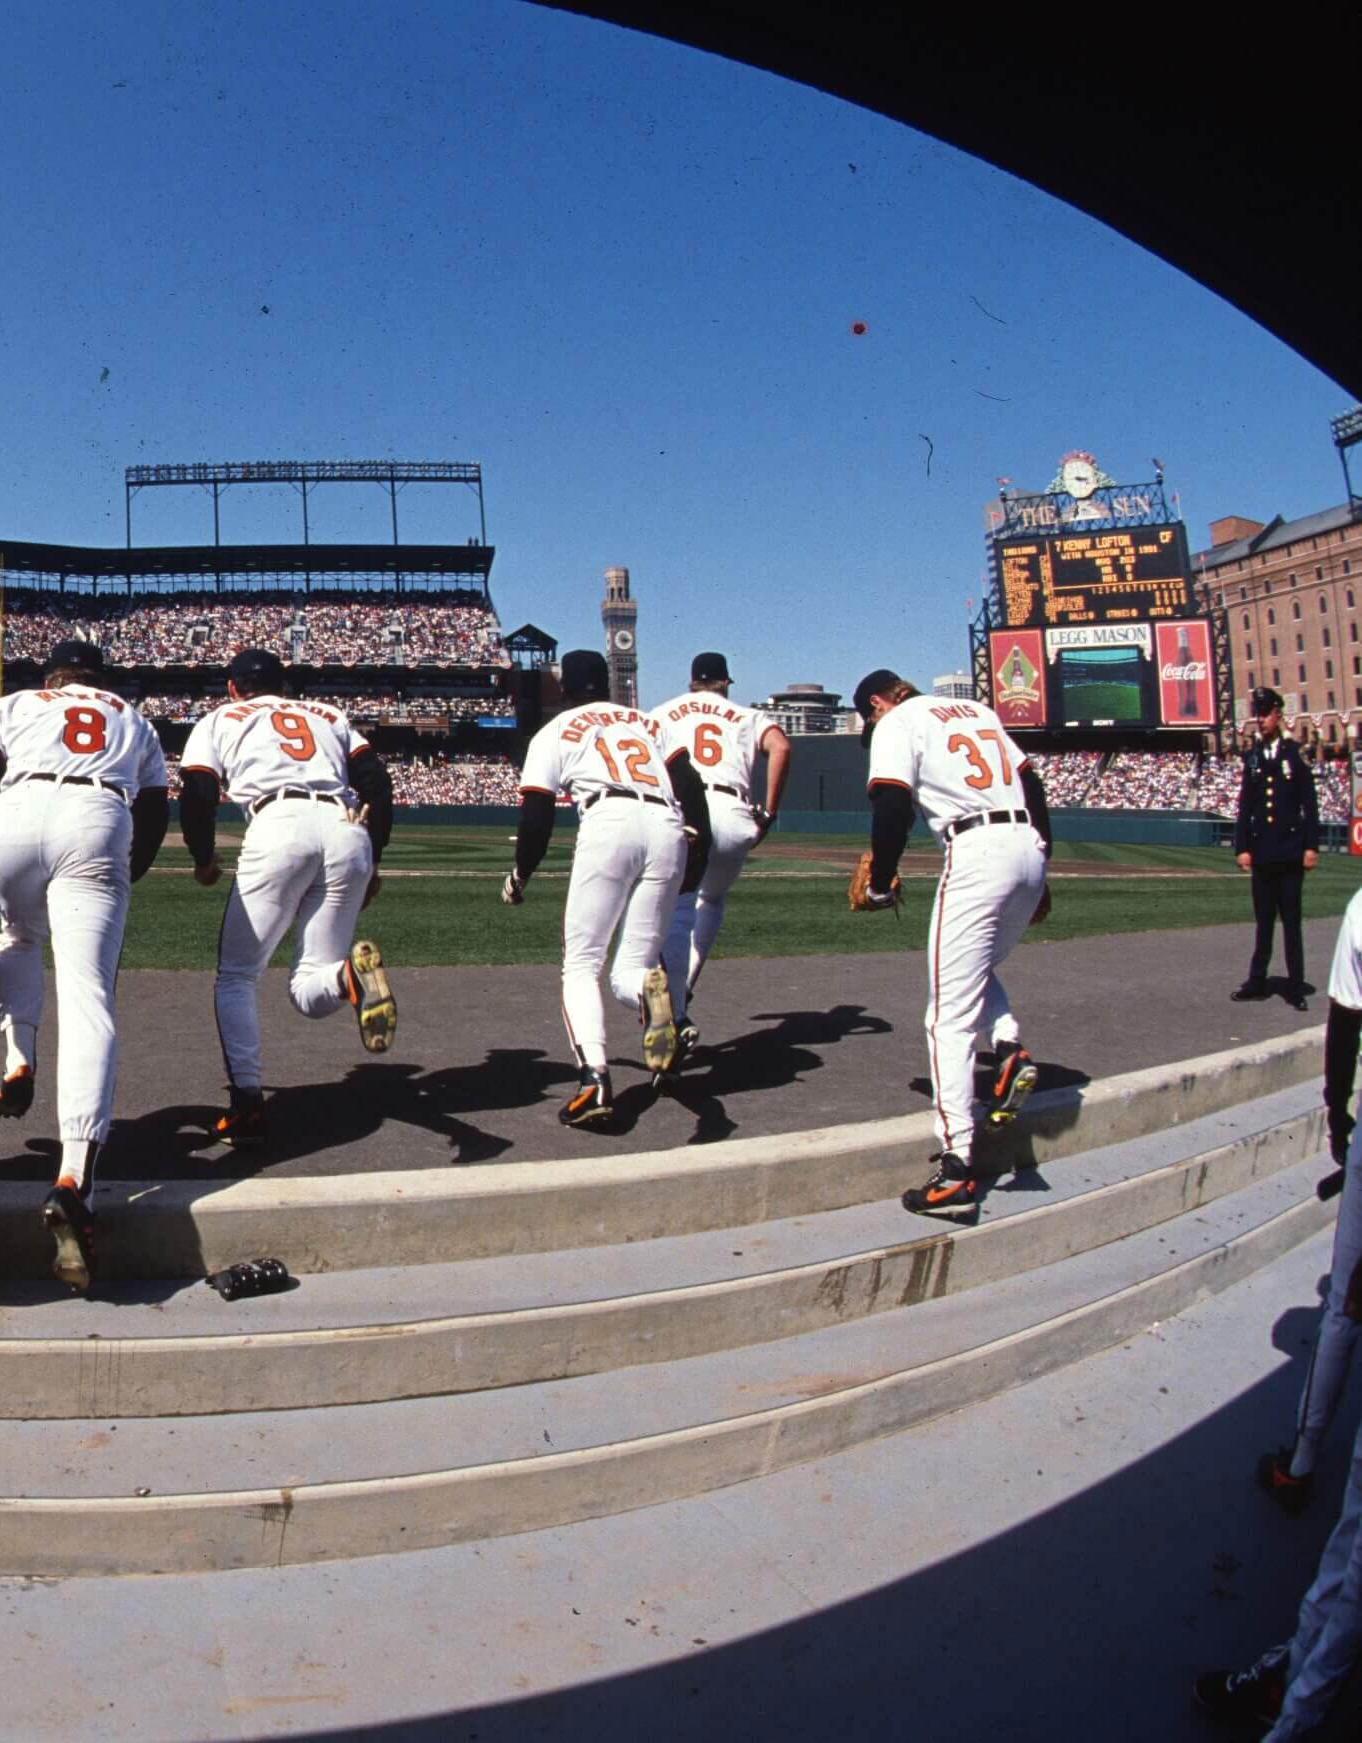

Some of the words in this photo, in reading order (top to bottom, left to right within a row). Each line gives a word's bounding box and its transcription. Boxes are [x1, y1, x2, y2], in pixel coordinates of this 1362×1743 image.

[1019, 505, 1058, 528] THE
[1112, 495, 1151, 518] SUN
[1054, 541, 1061, 552] 7
[1063, 538, 1091, 552] KENNY
[1095, 534, 1131, 549] LOFTON
[1159, 530, 1173, 543] CF
[1061, 551, 1082, 560] WITH
[1050, 629, 1087, 646] LEGG
[1093, 626, 1147, 644] MASON
[62, 706, 107, 755] 8
[269, 711, 317, 762] 9
[693, 722, 724, 767] 6
[593, 736, 661, 787] 12
[948, 728, 1013, 792] 37
